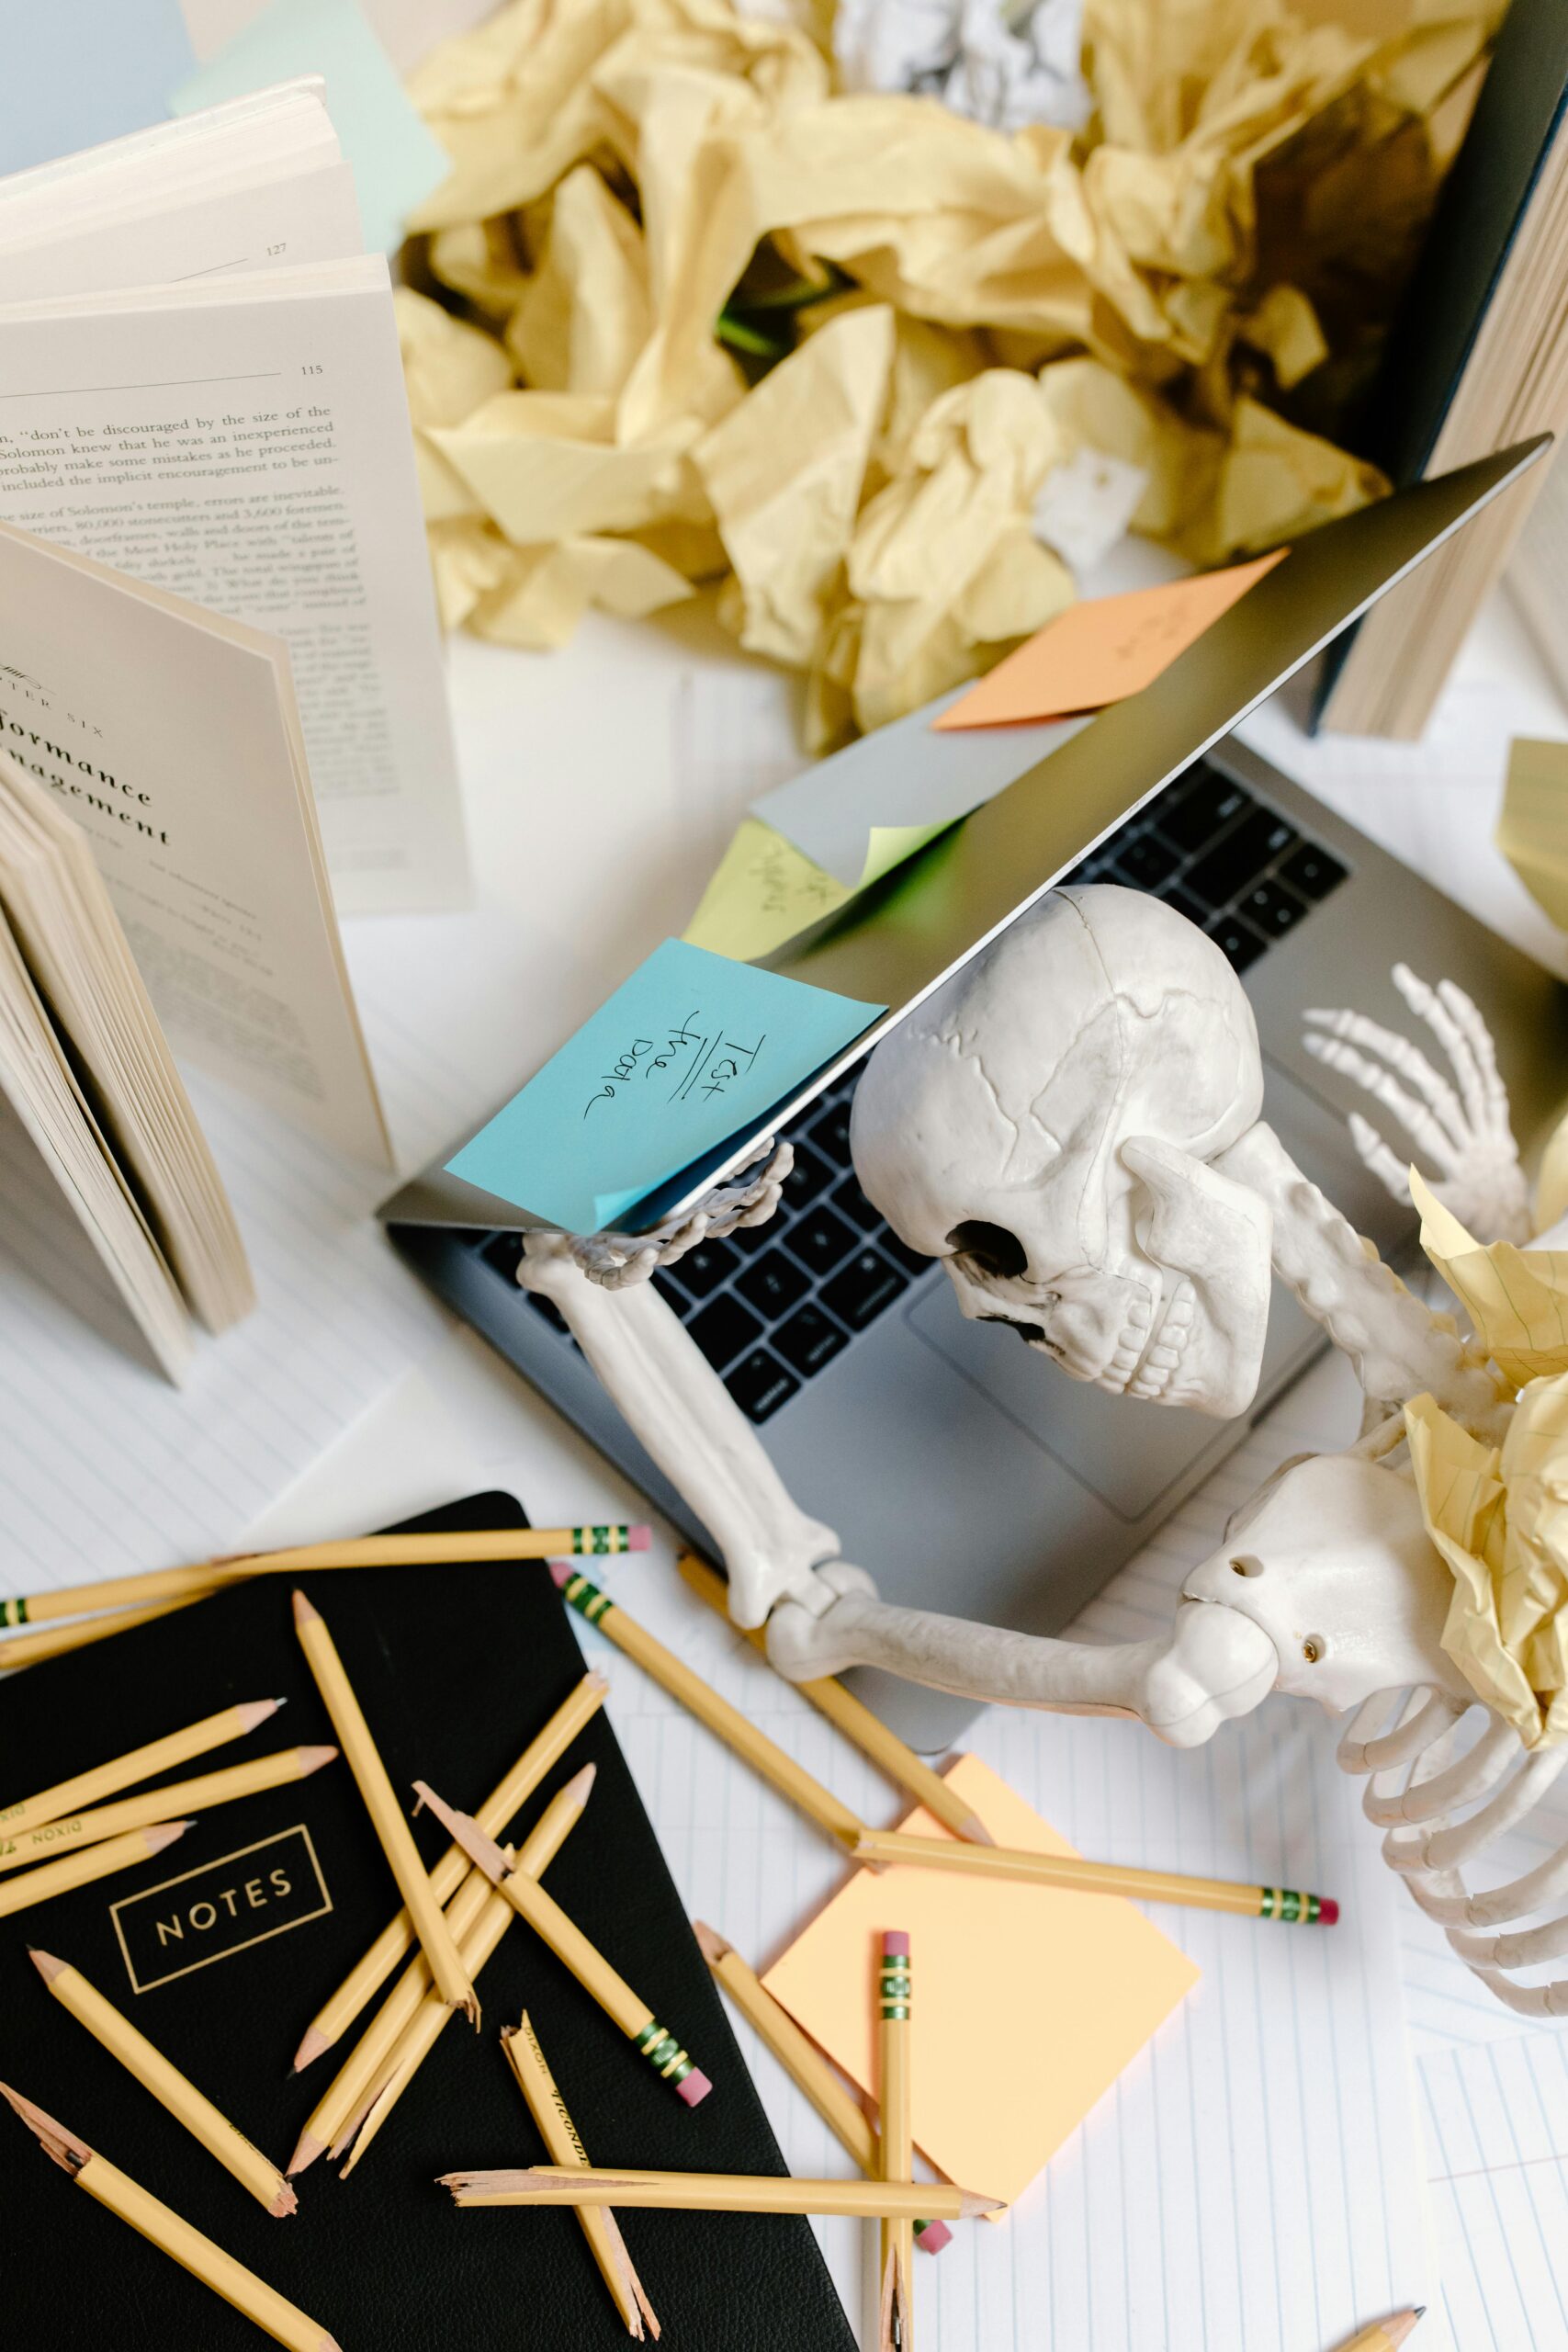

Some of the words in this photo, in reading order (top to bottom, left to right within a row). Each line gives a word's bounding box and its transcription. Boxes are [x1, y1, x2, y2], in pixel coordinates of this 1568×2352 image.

[266, 243, 287, 256] 127
[301, 365, 323, 376] 115
[71, 443, 112, 455] knew
[118, 439, 147, 451] that
[152, 437, 171, 449] he
[177, 437, 204, 447] was
[209, 435, 227, 445] an
[232, 421, 333, 442] inexperienced
[76, 426, 96, 438] be
[103, 418, 189, 435] discouraged
[196, 417, 215, 431] by
[222, 414, 245, 426] the
[253, 412, 278, 423] size
[286, 407, 302, 419] of
[308, 406, 332, 417] the
[65, 458, 103, 470] make
[109, 458, 148, 468] some
[152, 451, 213, 465] mistakes
[218, 451, 231, 460] as
[235, 446, 254, 458] he
[258, 437, 336, 458] proceeded.
[2, 477, 65, 492] included
[69, 475, 92, 487] the
[97, 471, 152, 485] implicit
[157, 462, 268, 480] encouragement
[272, 461, 288, 470] to
[292, 457, 310, 468] be
[19, 510, 45, 521] size
[50, 507, 64, 518] of
[204, 496, 245, 507] errors
[248, 494, 270, 503] are
[67, 712, 104, 738] SIX
[646, 1011, 701, 1079] the
[31, 1819, 83, 1845] DIXON
[155, 1868, 292, 1947] NOTES
